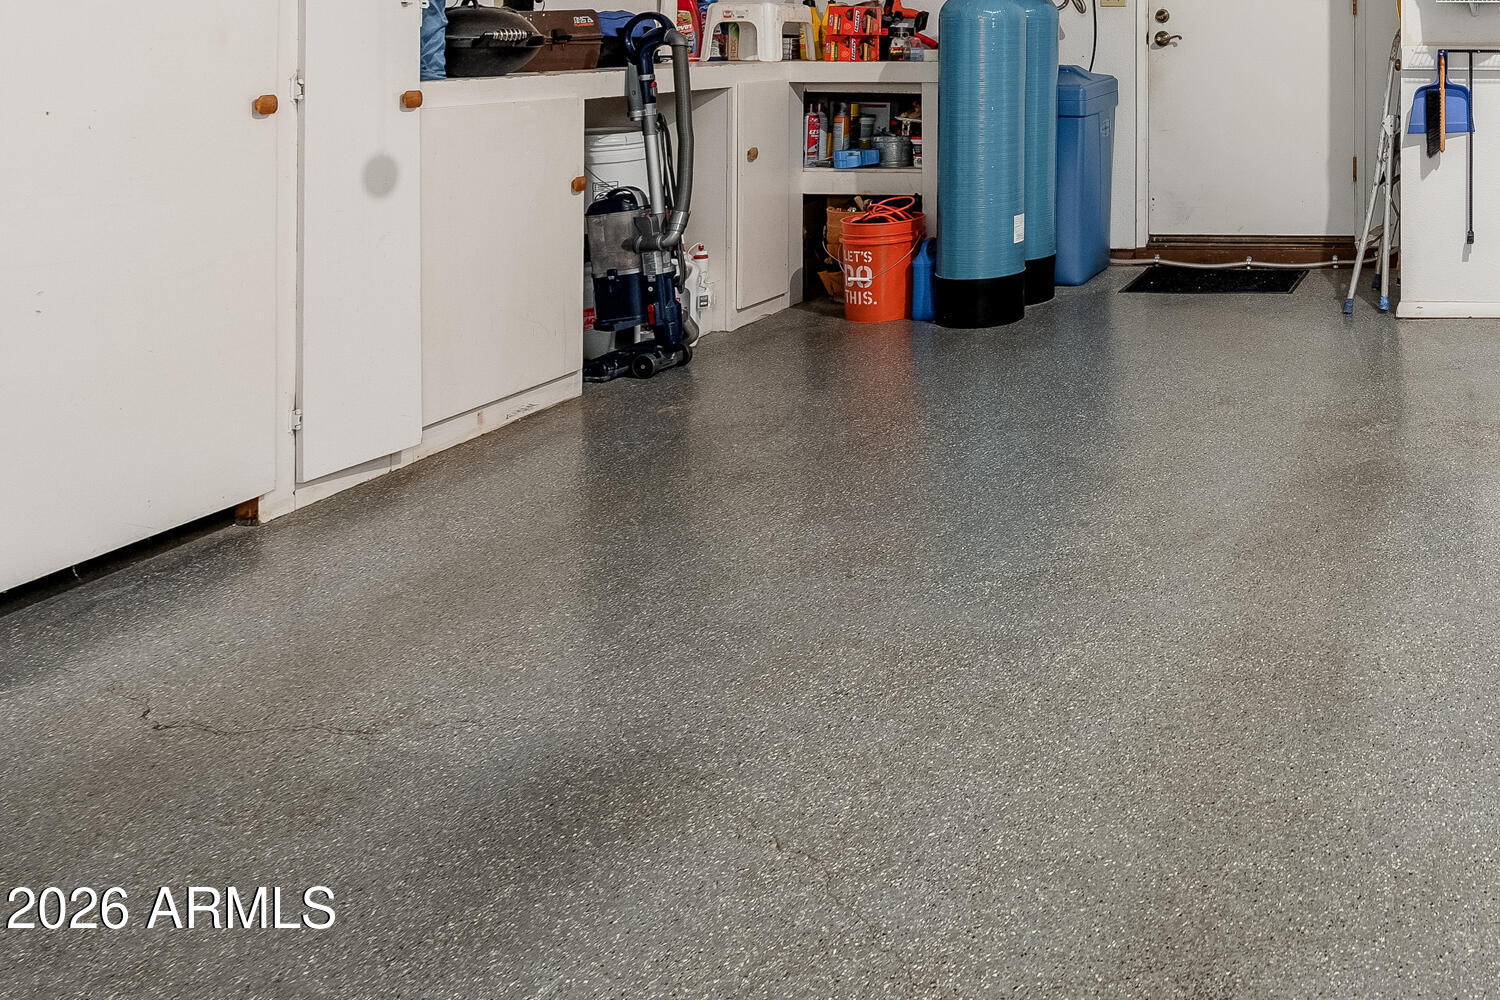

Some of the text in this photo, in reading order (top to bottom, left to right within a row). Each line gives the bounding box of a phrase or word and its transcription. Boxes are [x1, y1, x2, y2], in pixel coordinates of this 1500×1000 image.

[844, 250, 872, 263] LET'S
[845, 264, 873, 289] DO
[845, 289, 878, 305] THIS.
